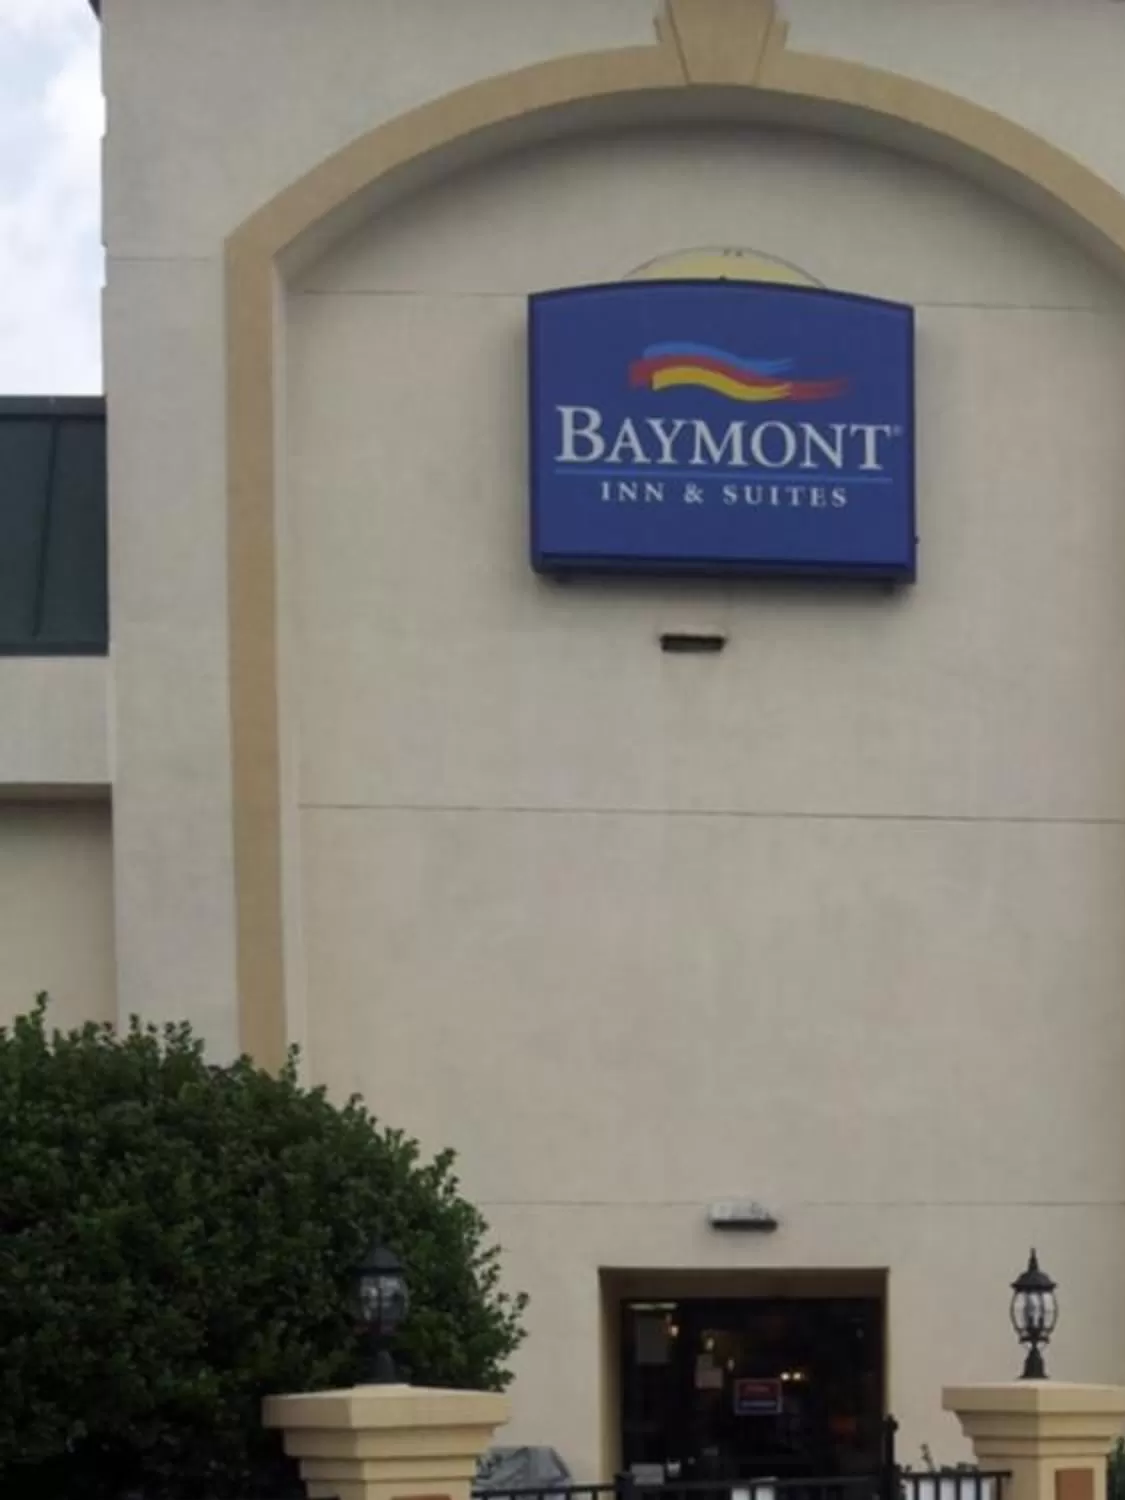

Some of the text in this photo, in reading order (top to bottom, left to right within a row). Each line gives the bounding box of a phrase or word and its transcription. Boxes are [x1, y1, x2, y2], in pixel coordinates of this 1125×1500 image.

[555, 404, 892, 471] BAYMONT
[601, 481, 848, 508] INN & SUITES
